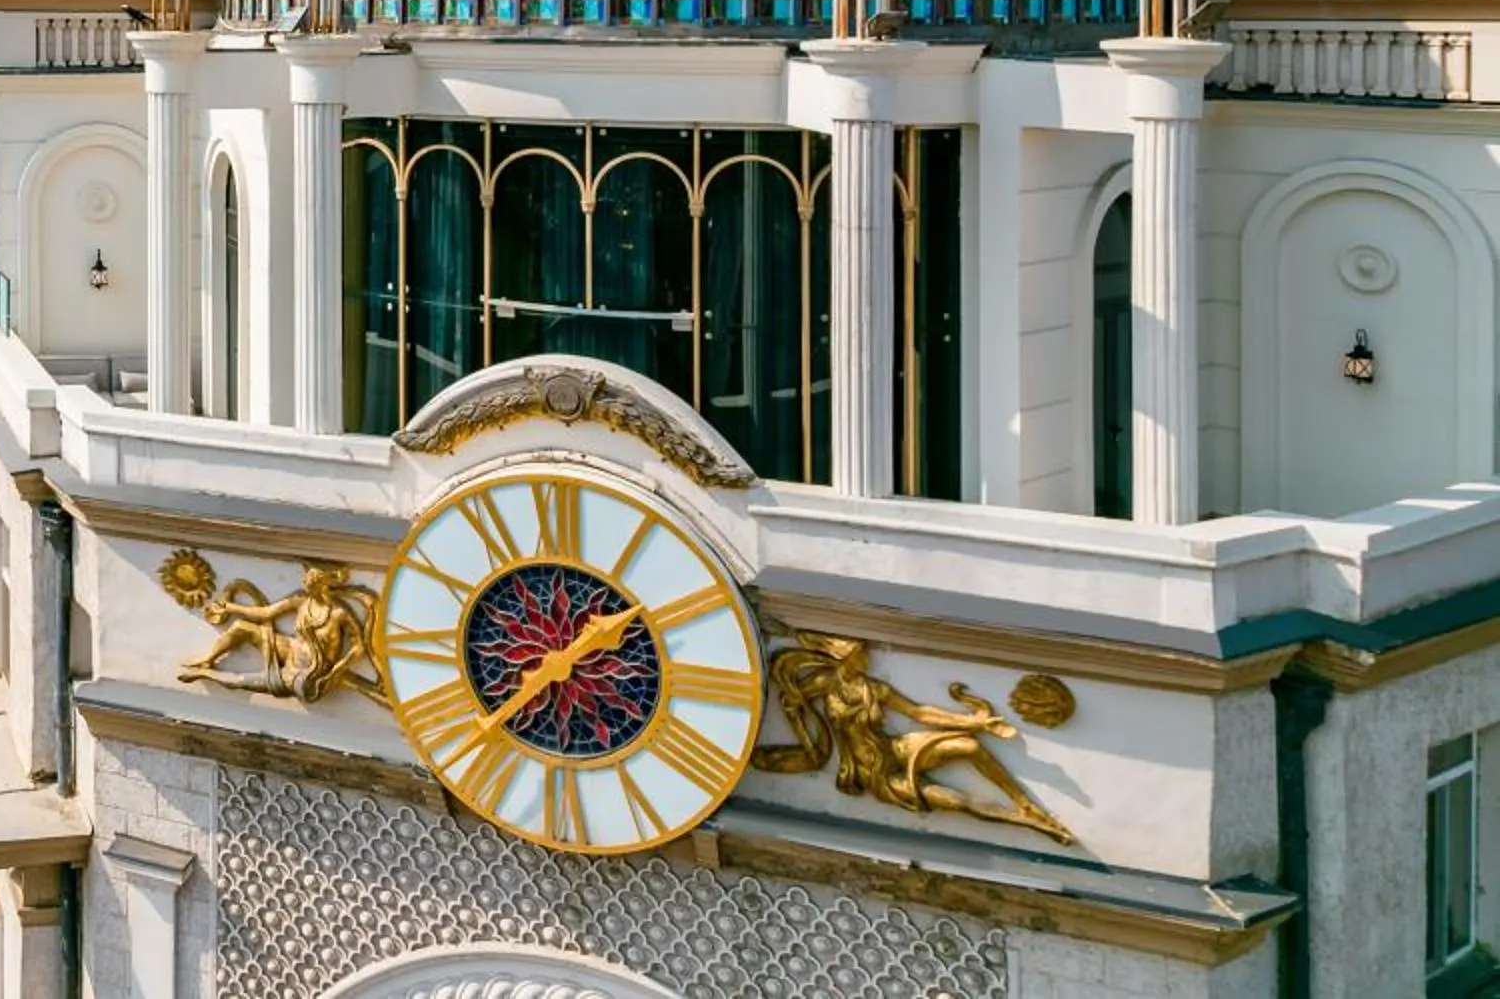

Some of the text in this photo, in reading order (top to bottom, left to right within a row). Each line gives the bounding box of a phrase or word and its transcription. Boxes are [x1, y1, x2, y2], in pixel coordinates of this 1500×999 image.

[456, 491, 521, 570] XI
[531, 482, 581, 558] XII
[386, 621, 458, 664] IX
[650, 583, 732, 630] II
[669, 663, 755, 706] III
[544, 765, 589, 844] VI
[617, 764, 669, 839] V
